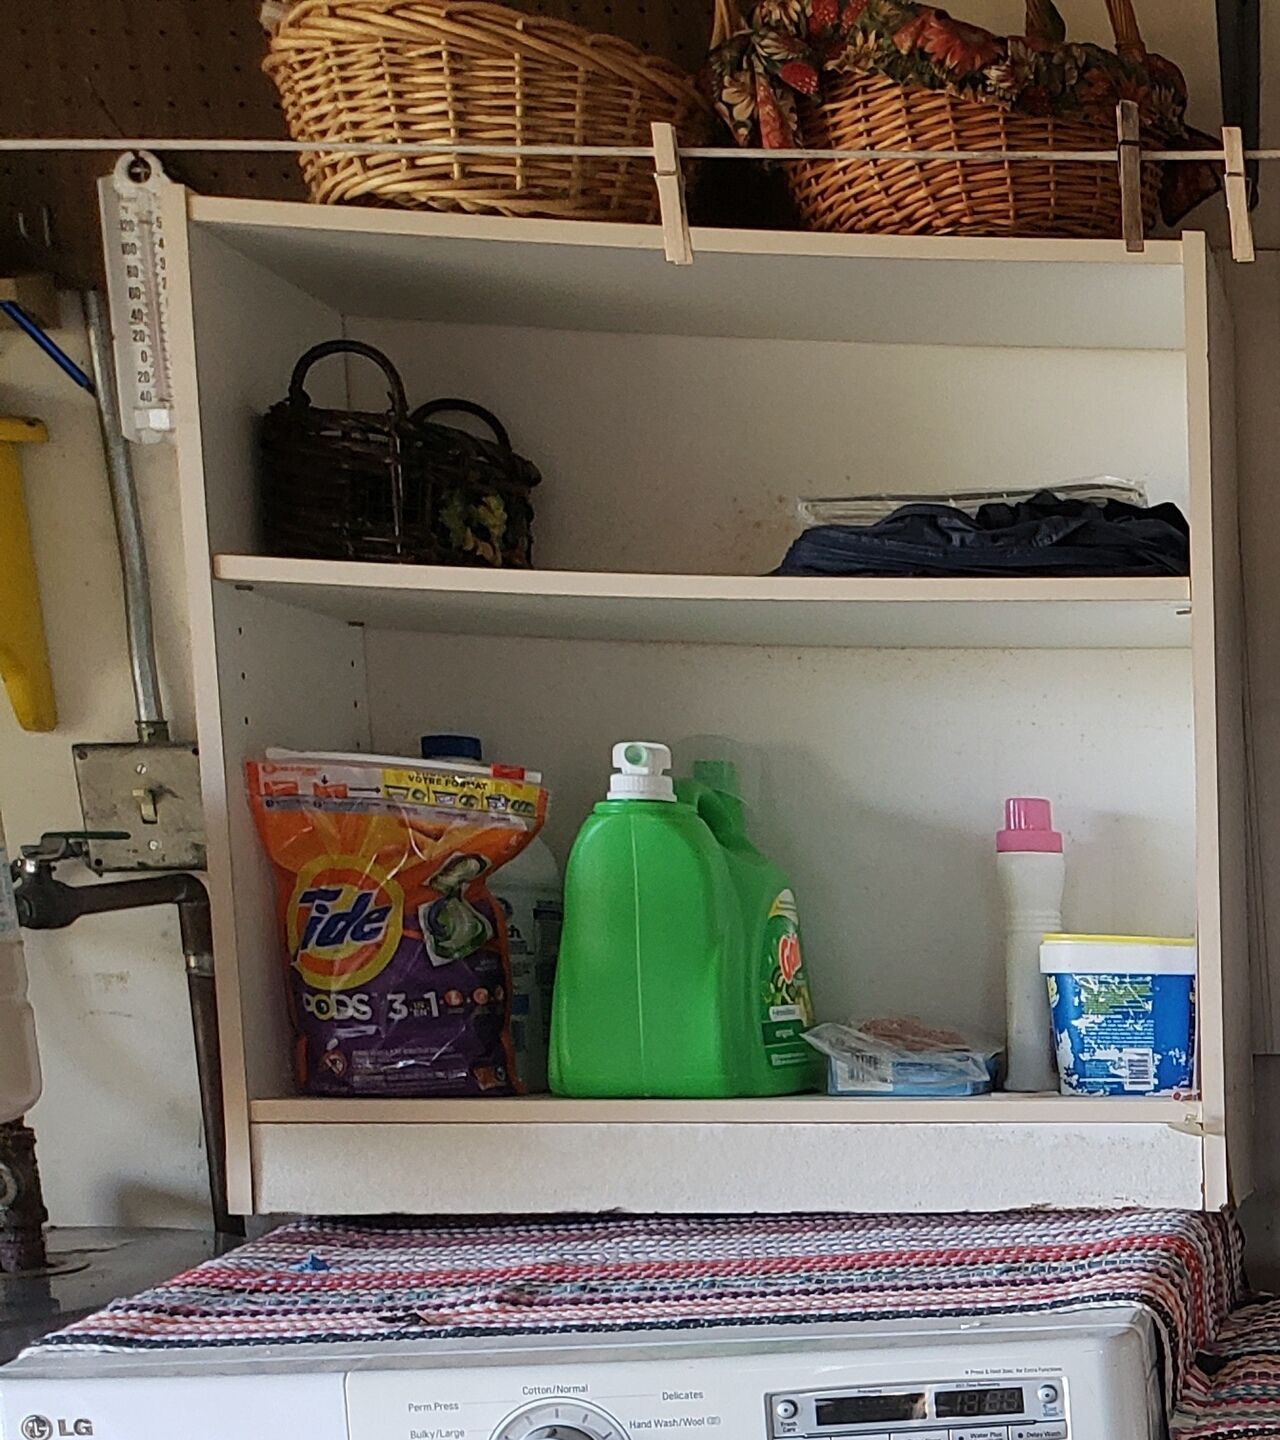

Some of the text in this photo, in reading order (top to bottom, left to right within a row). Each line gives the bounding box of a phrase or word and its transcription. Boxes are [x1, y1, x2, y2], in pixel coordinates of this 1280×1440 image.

[131, 308, 144, 321] 40
[132, 330, 145, 342] 20
[140, 349, 148, 363] 0
[138, 371, 150, 383] 20
[140, 390, 153, 402] 40
[407, 774, 442, 785] VOTRE
[298, 886, 393, 951] Tide
[303, 992, 372, 1021] PODS
[386, 992, 409, 1020] 3
[424, 991, 439, 1018] 1
[521, 1383, 589, 1395] Cotton/Normal
[661, 1390, 704, 1401] Delicates
[57, 1418, 93, 1437] LG
[629, 1416, 706, 1429] Hand Wash/Wool
[410, 1428, 465, 1440] Bulky/Large
